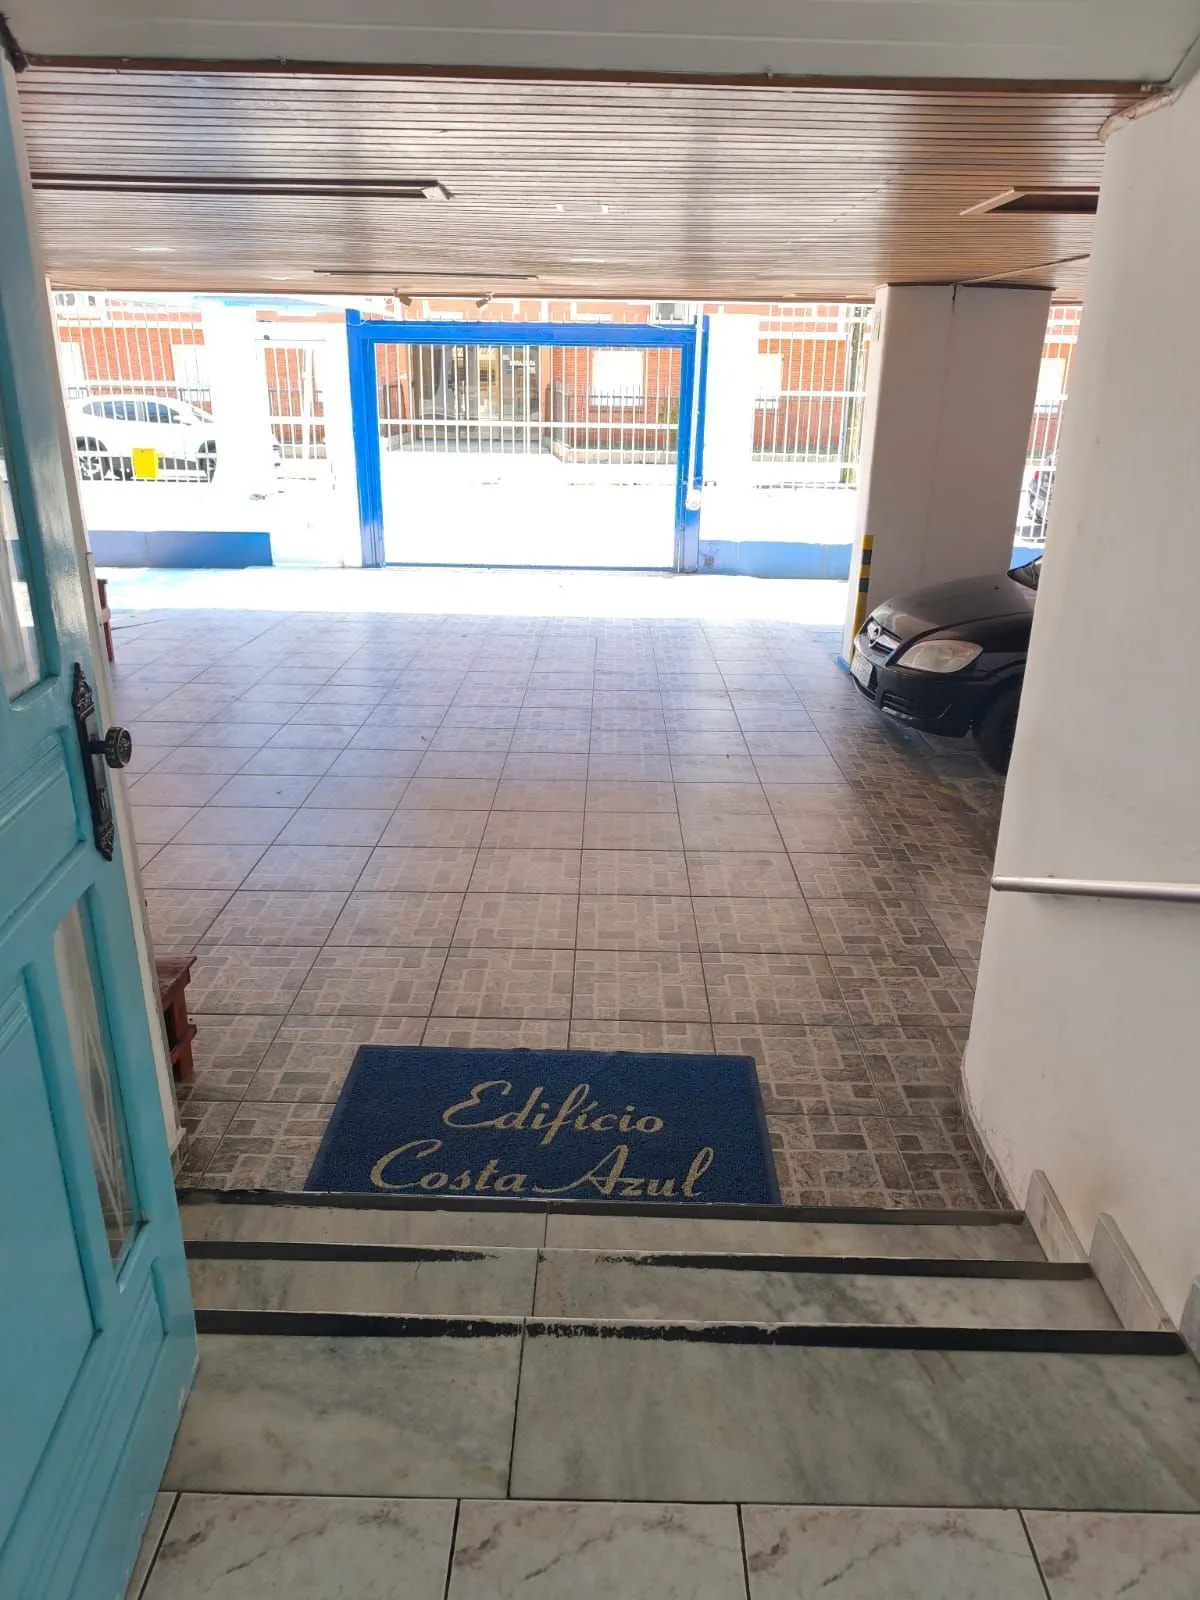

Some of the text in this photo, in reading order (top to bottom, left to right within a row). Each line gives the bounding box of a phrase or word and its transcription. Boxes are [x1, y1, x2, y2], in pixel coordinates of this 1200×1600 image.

[441, 1079, 664, 1146] Edifício
[369, 1138, 714, 1198] Costa Azul
